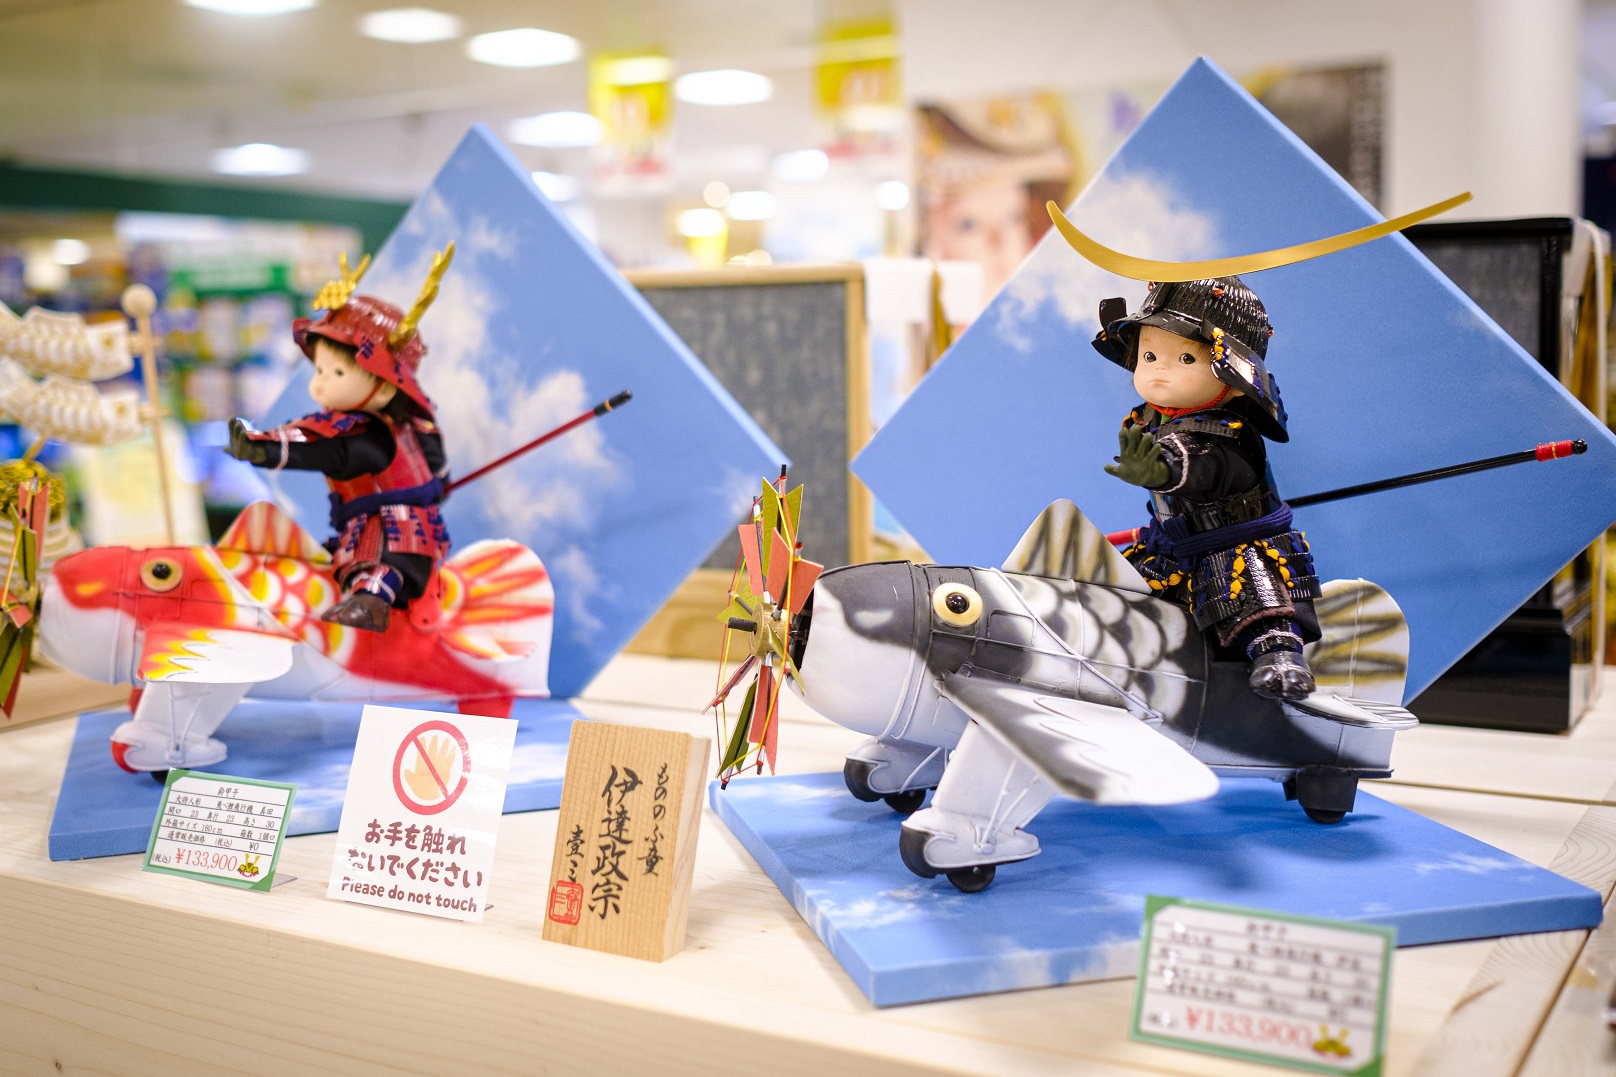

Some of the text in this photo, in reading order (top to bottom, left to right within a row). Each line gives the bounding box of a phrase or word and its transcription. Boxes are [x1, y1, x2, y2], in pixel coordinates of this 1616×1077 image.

[190, 809, 199, 818] 23
[226, 814, 235, 823] 23
[265, 820, 275, 829] 30
[364, 818, 467, 855] お手を触れ
[175, 848, 238, 871] ¥133,900
[588, 764, 644, 920] 伊達政宗
[341, 876, 477, 913] Please do not touch
[1185, 1005, 1312, 1050] ¥133,900
